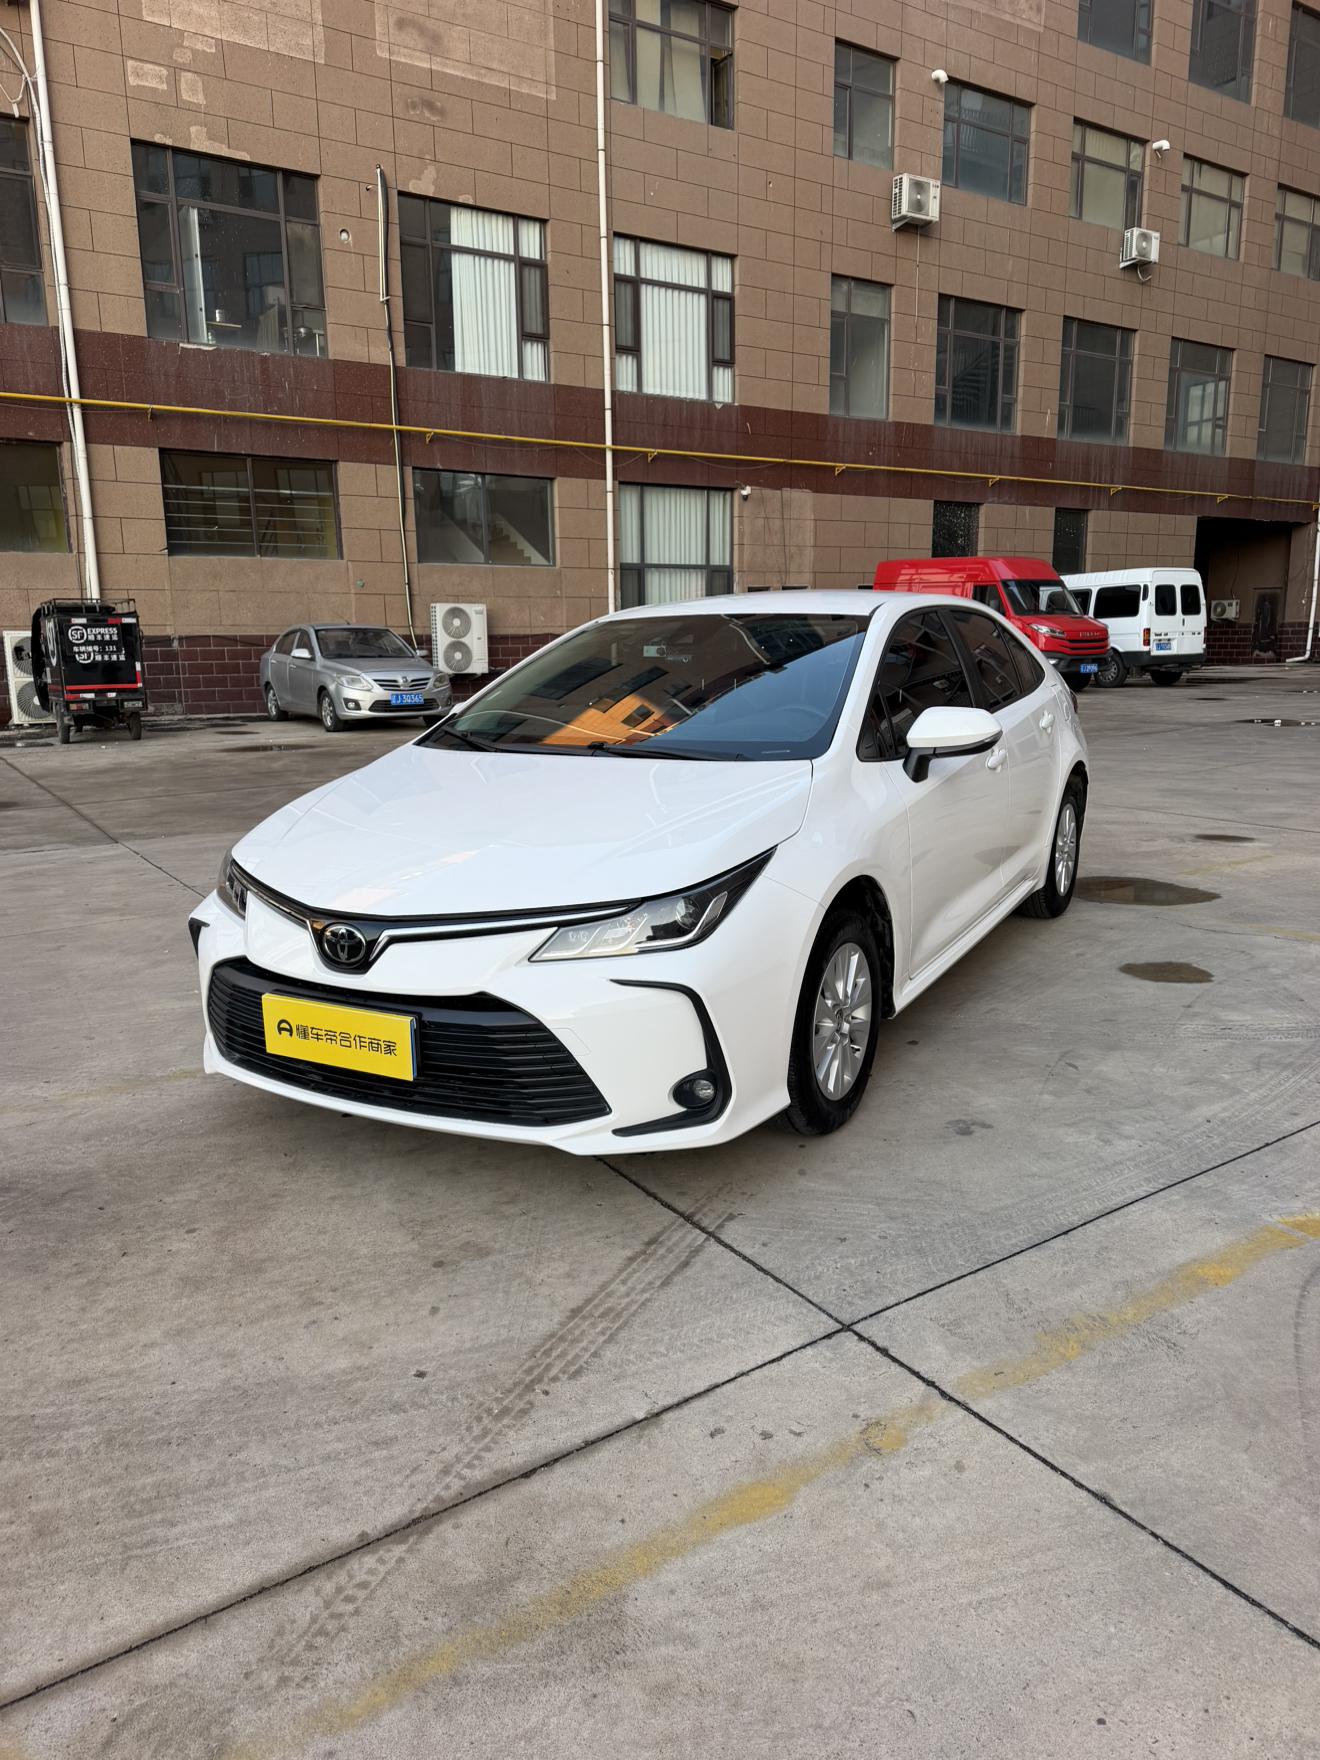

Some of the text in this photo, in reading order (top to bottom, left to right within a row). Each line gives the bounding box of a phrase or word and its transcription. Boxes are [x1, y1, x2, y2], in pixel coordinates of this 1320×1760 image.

[295, 1024, 398, 1057] 懂车帝合作商家
